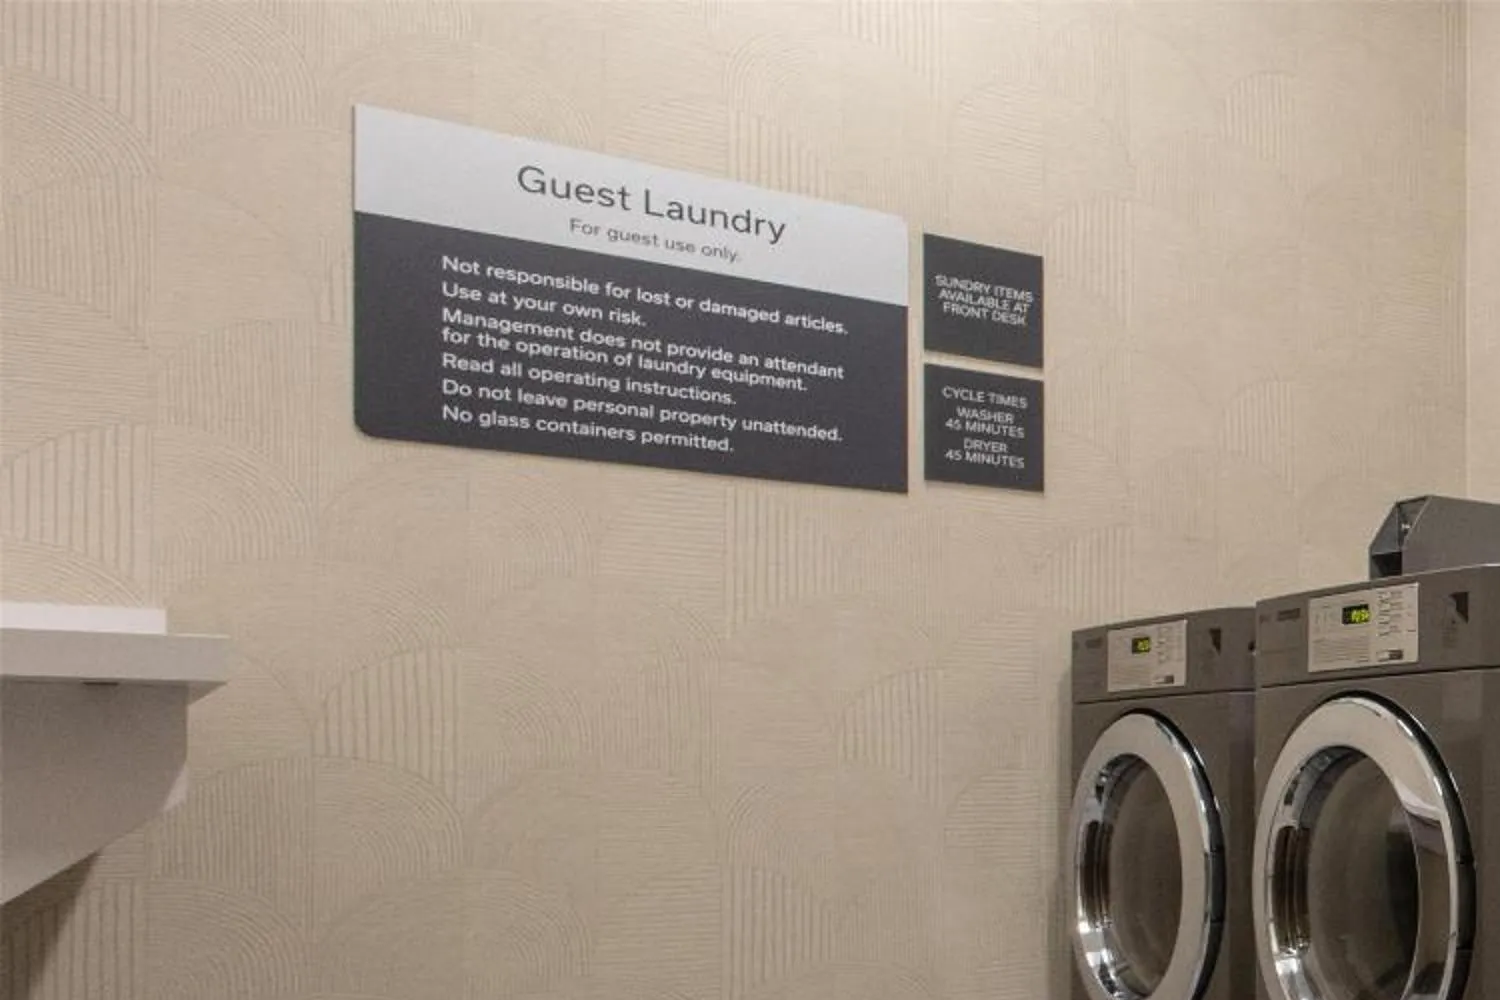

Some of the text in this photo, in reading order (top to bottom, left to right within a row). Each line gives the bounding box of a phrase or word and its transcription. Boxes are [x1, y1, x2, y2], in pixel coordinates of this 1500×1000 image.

[517, 165, 786, 245] Guest Laundry
[569, 217, 741, 264] For guest use only.
[442, 255, 849, 334] Not responsible for lost or damaged articles.
[442, 281, 646, 327] Use at your own risk.
[935, 274, 1034, 303] SUNDRY ITEMS
[938, 288, 1030, 314] AVAILABLE AT
[943, 301, 1026, 325] FRONT DESK
[441, 326, 808, 391] for the operation of laundry equipment.
[442, 307, 844, 380] Management does not provide an attendant
[442, 351, 737, 405] Read all operating instructions.
[941, 385, 1028, 409] CYCLE TIMES
[442, 377, 843, 442] Do not leave personal property unattended.
[442, 404, 734, 452] No glass containers permitted.
[945, 418, 1025, 439] 45 MINUTES
[956, 406, 1014, 425] WASHER
[945, 449, 1025, 469] 45 MINUTES
[963, 437, 1008, 453] DRYER
